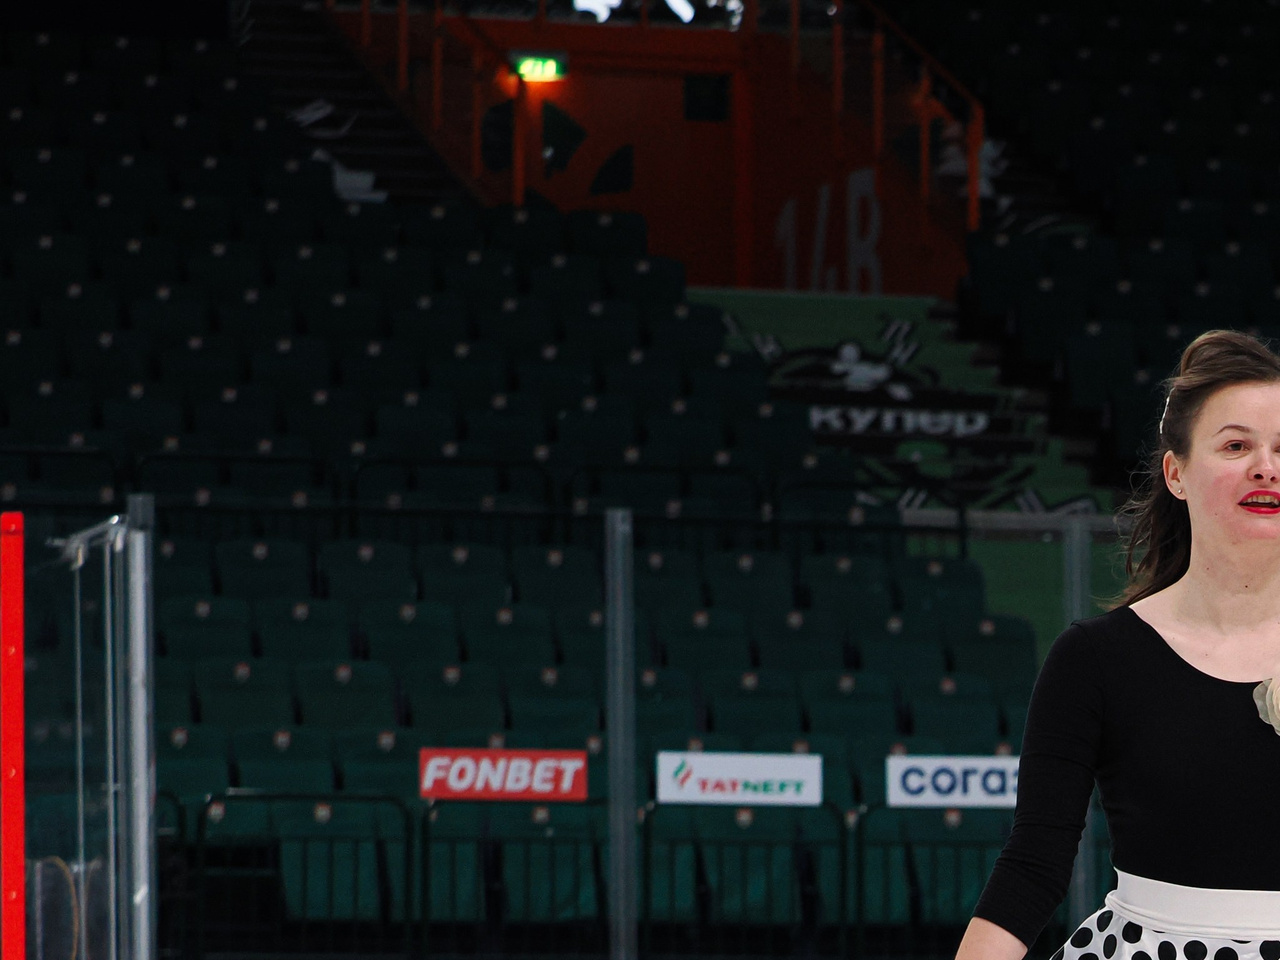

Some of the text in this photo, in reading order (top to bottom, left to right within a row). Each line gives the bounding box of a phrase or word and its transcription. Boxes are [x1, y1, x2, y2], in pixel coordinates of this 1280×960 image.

[422, 756, 584, 793] FONBET
[697, 777, 806, 794] TATNEFT
[901, 767, 1019, 797] сога
